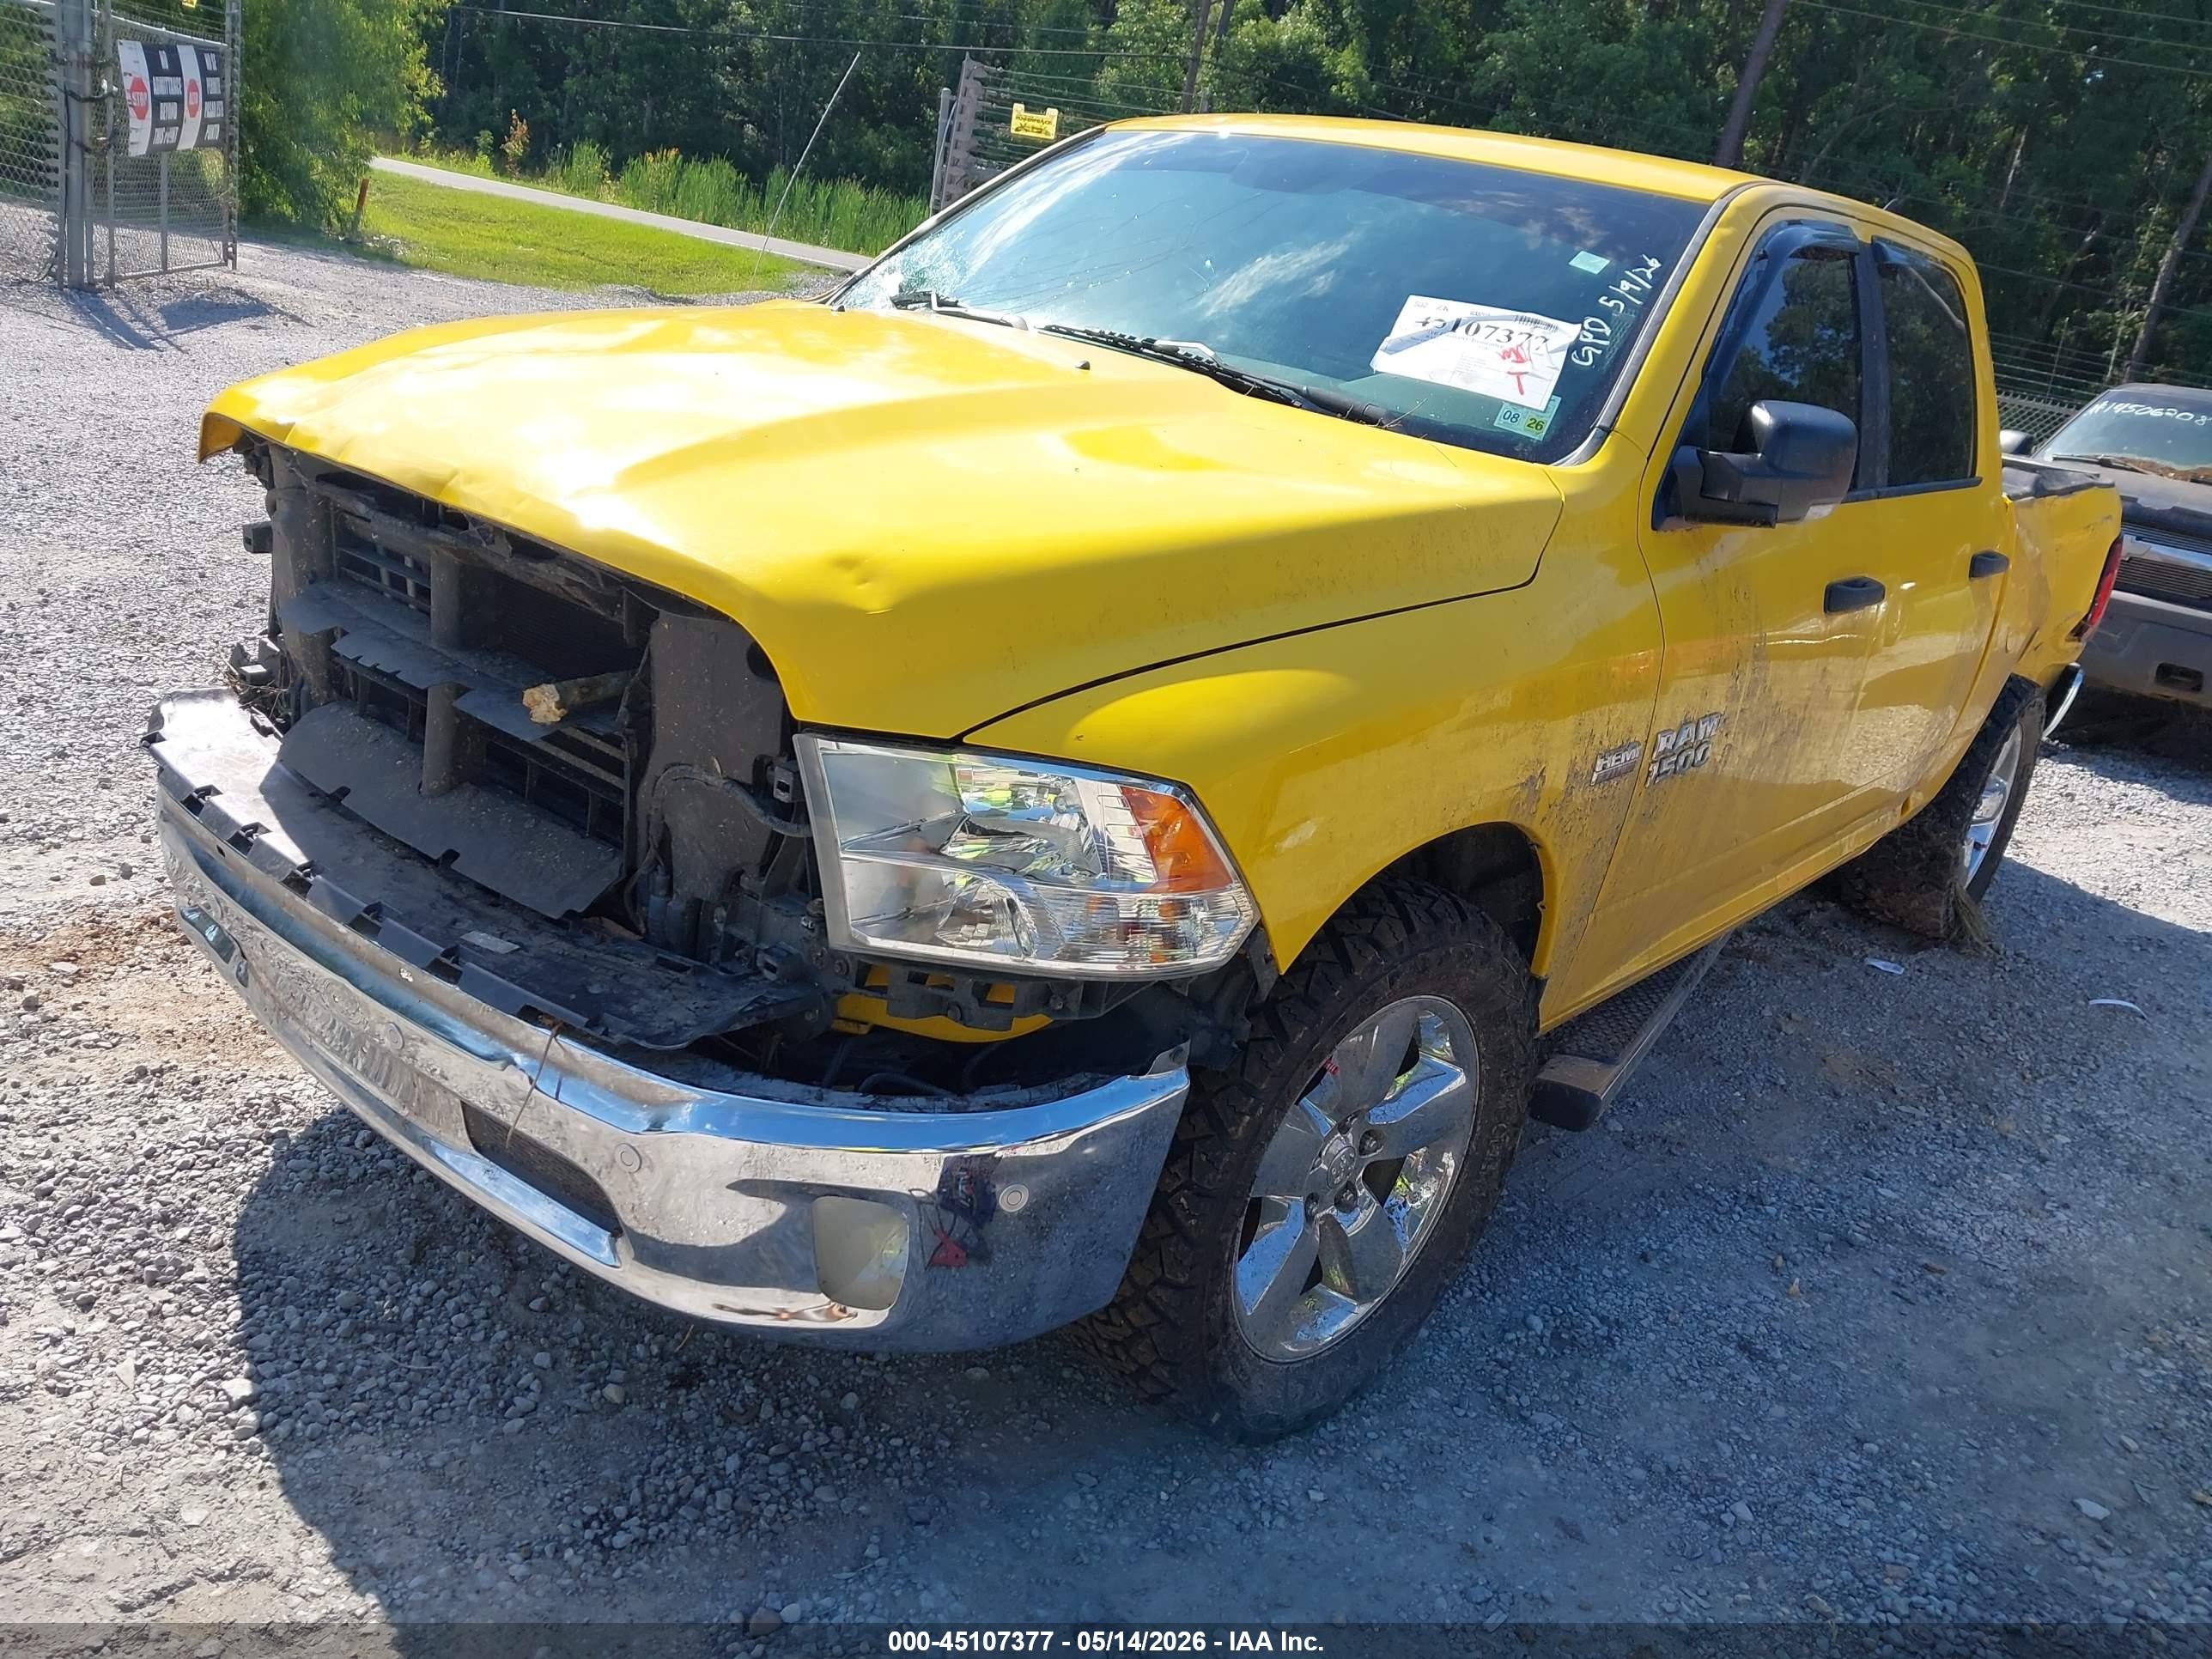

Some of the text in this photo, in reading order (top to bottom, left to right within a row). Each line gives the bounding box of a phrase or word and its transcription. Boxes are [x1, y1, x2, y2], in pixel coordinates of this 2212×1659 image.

[131, 91, 148, 106] STOP
[1503, 410, 1545, 431] 08 26
[1652, 713, 1723, 760] RAM
[1595, 744, 1640, 772] HEMI
[1644, 740, 1712, 787] 1500
